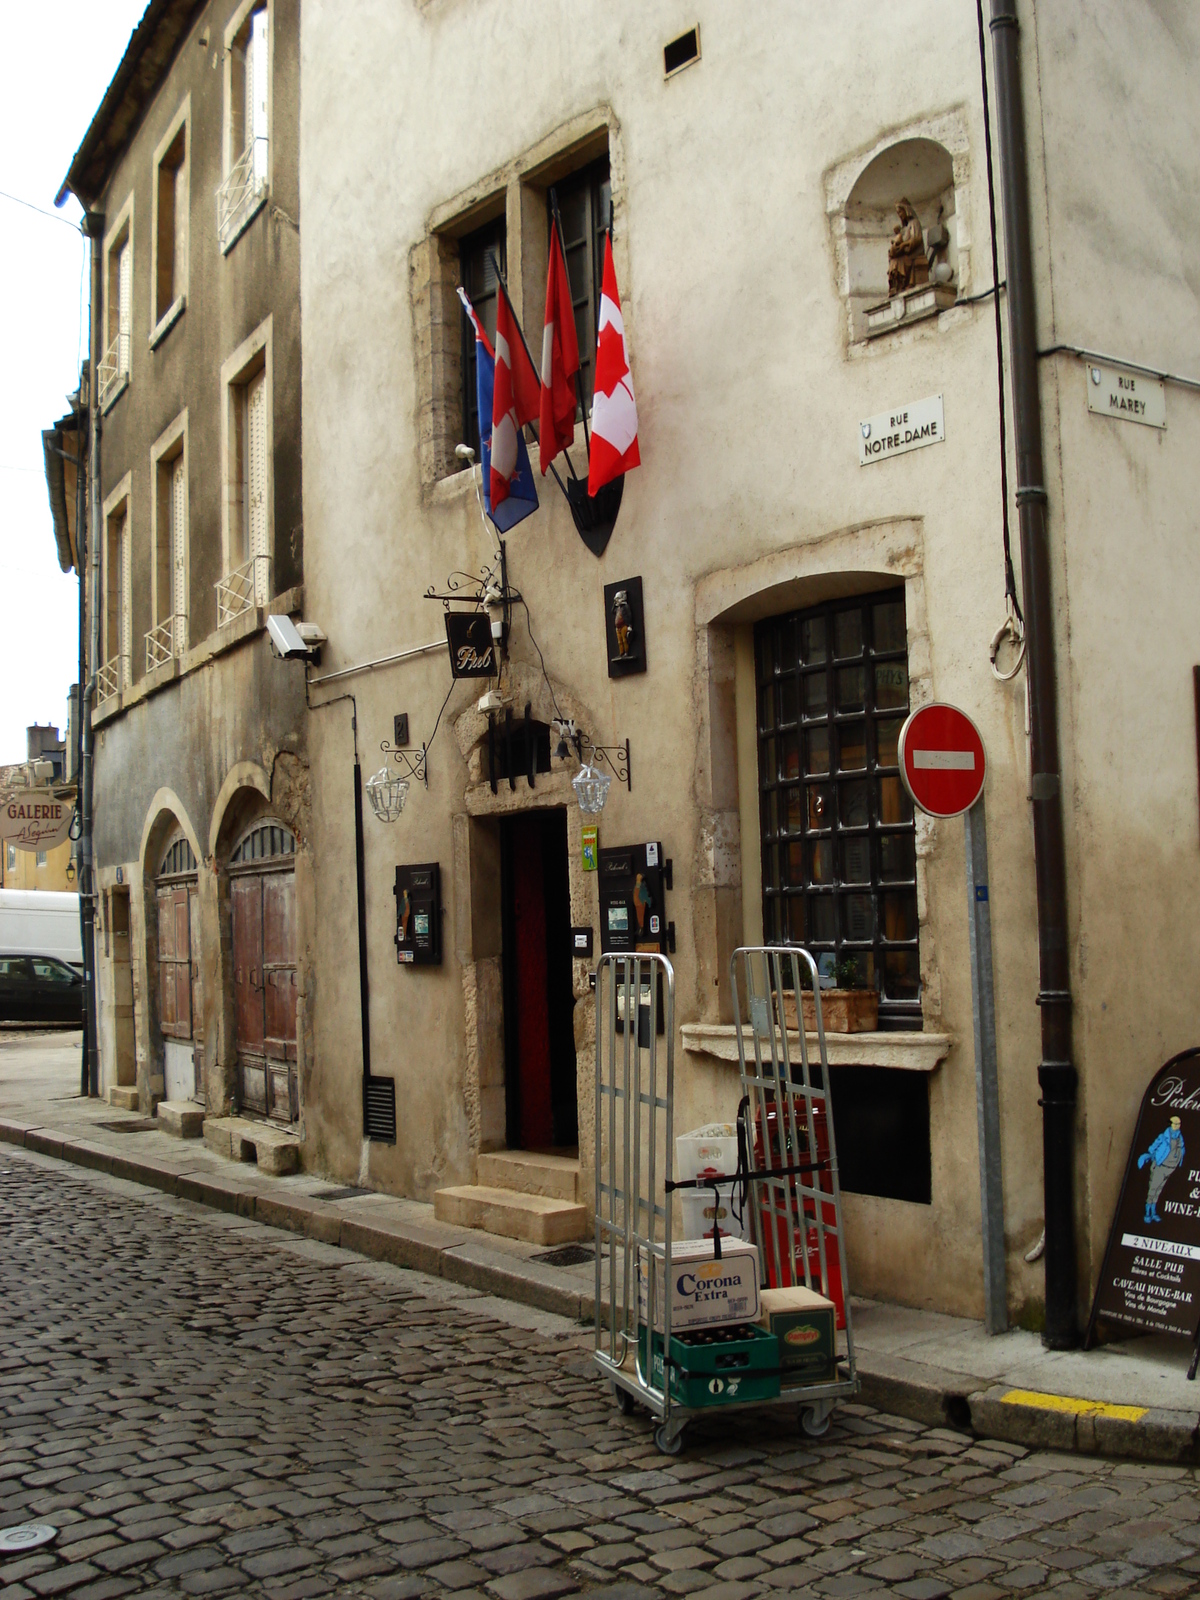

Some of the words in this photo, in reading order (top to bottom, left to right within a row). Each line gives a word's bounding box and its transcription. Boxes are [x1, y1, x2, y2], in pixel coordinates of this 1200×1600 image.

[1118, 376, 1136, 392] RUE
[1109, 393, 1146, 416] MAREY
[890, 412, 908, 428] RUE
[864, 421, 937, 457] NOTRE-DAME
[456, 645, 493, 670] Pub
[396, 720, 405, 740] 2
[7, 803, 62, 820] GALERIE
[1132, 1237, 1140, 1246] 2
[1141, 1238, 1194, 1257] NIVEAUX
[1133, 1255, 1162, 1270] SALLE
[1164, 1261, 1185, 1274] PUB
[676, 1273, 742, 1297] Corona
[1112, 1277, 1146, 1293] CAVEAU
[694, 1290, 728, 1303] Extra
[1124, 1290, 1136, 1300] Vins
[1137, 1293, 1145, 1301] de
[1145, 1295, 1177, 1309] Bourgogne
[1124, 1299, 1136, 1309] Vins
[1137, 1302, 1146, 1311] du
[1146, 1305, 1167, 1316] Monde
